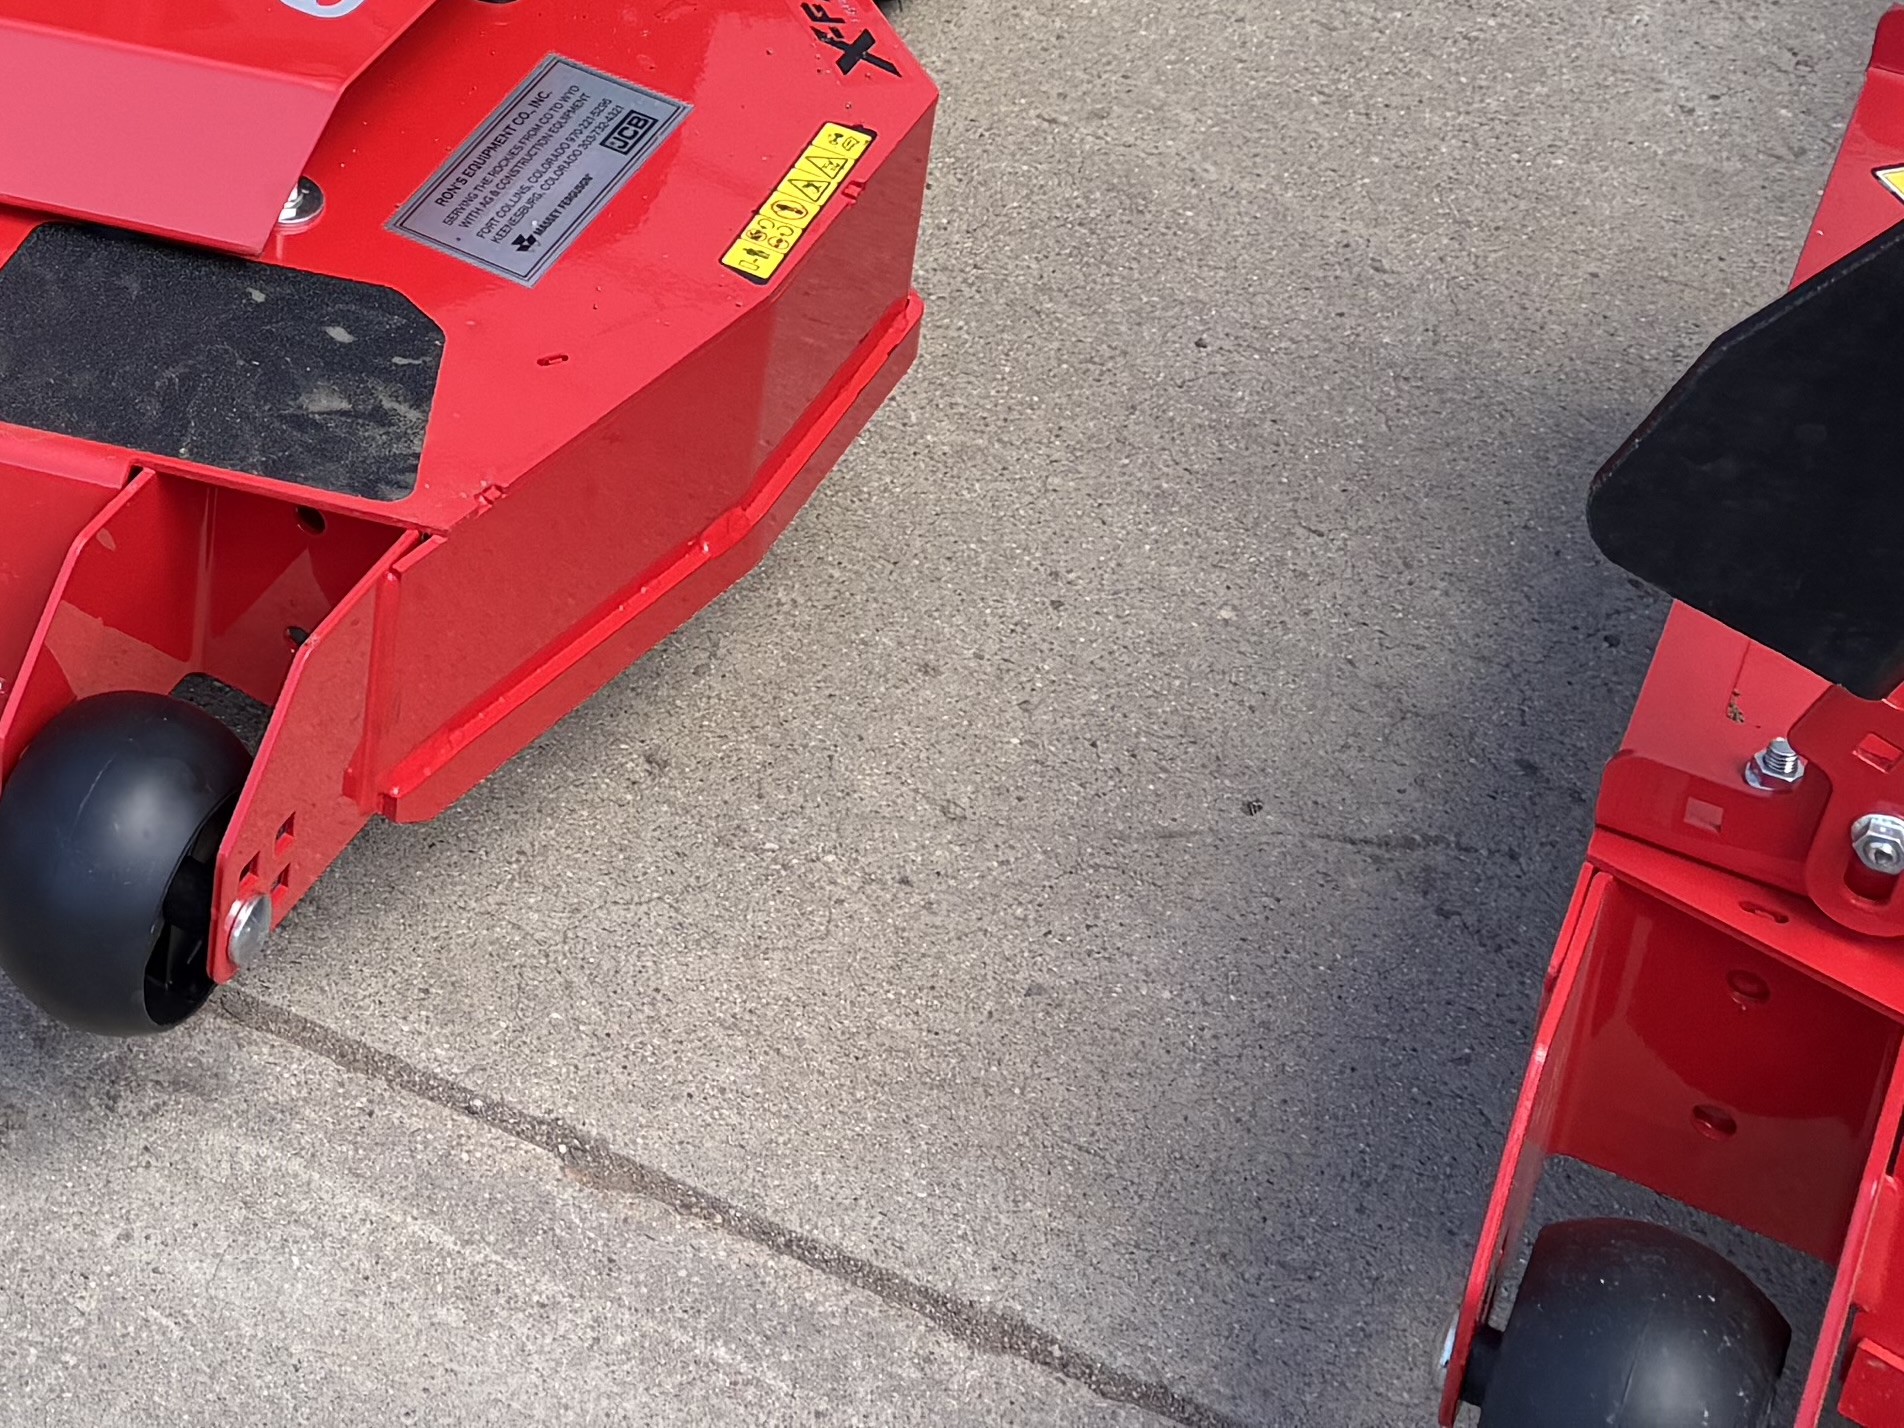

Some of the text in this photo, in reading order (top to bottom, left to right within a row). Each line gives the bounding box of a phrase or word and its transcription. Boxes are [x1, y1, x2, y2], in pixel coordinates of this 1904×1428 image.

[433, 176, 470, 207] RON'S
[460, 124, 519, 178] EQUIPMENT
[441, 84, 581, 226] SERVING THE ROCKIES FROM CO TO WYO
[457, 206, 485, 229] WITH
[477, 194, 496, 208] AG
[493, 132, 554, 191] CONSTRUCTION
[546, 92, 592, 134] EQUIPMENT
[538, 148, 585, 191] COLORADO
[607, 114, 651, 150] JCB
[474, 217, 502, 239] FORT
[525, 141, 572, 184] COLORADO
[531, 174, 594, 236] MASSEY FERGUSON
